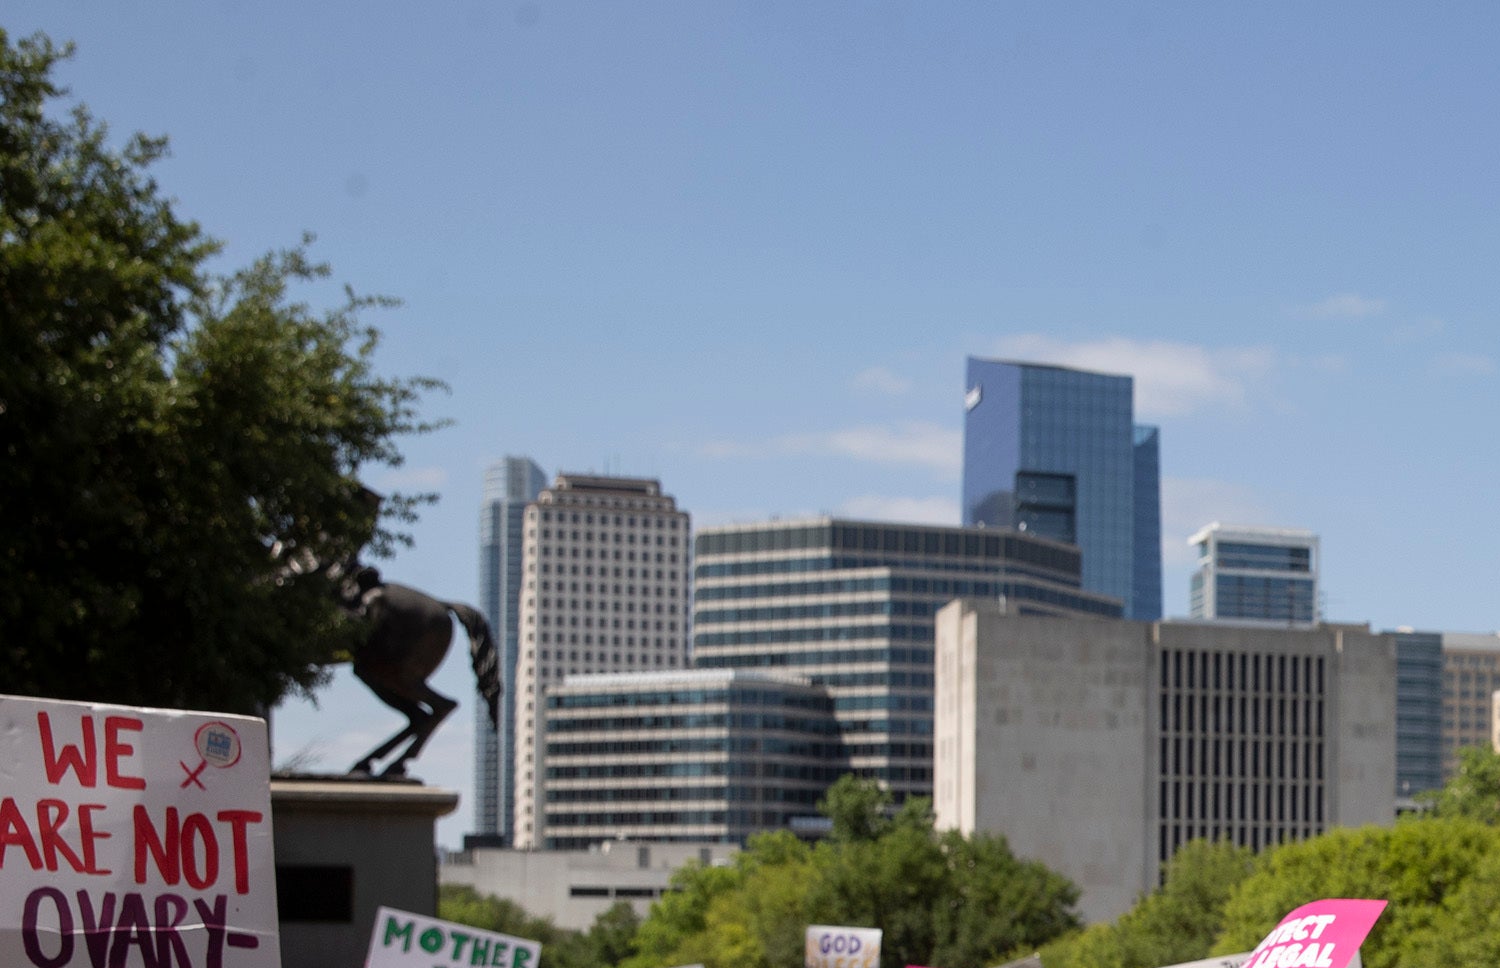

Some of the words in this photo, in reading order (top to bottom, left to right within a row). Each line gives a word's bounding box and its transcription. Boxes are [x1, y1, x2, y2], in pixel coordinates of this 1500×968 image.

[38, 712, 146, 790] WE
[0, 798, 112, 876] ARE
[134, 805, 263, 894] NOT
[820, 933, 861, 954] GOD
